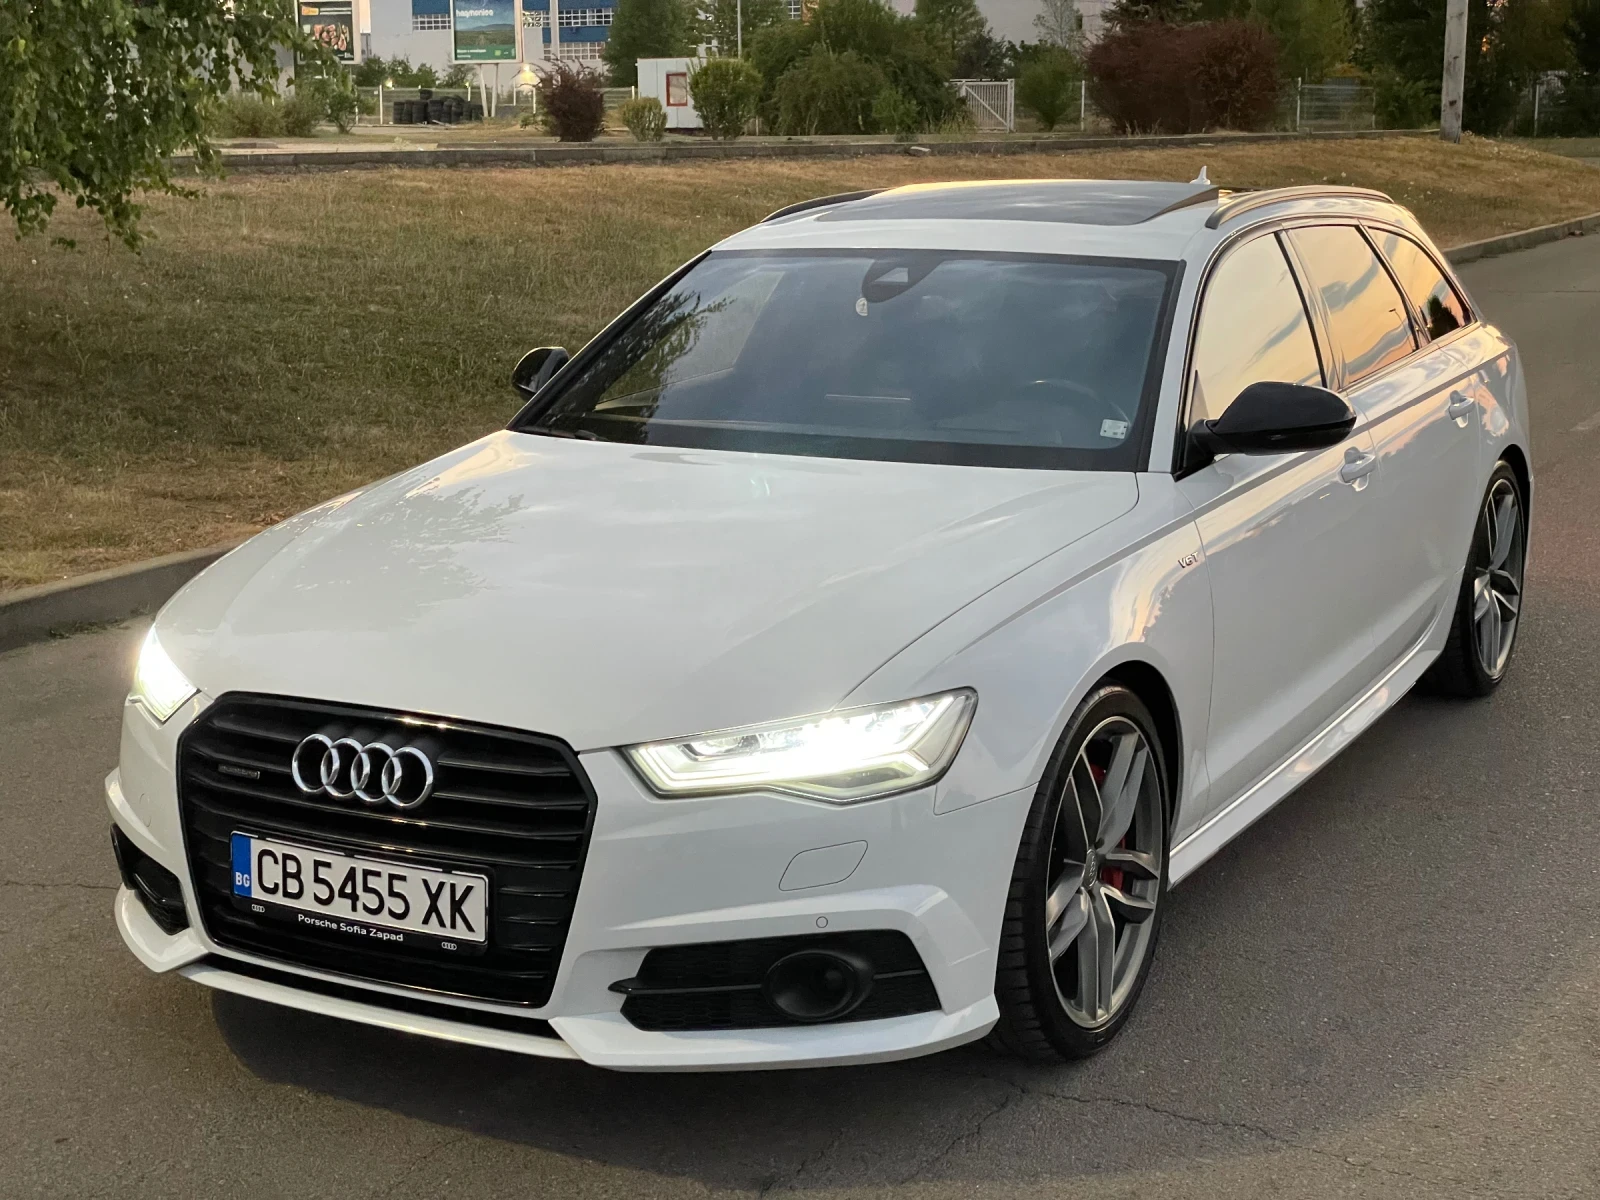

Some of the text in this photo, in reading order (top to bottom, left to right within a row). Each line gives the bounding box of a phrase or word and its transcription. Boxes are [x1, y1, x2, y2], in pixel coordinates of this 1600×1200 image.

[235, 871, 250, 887] BG
[257, 848, 476, 933] CB 5455 XK
[297, 914, 404, 942] Porsche Sofia Zapad
